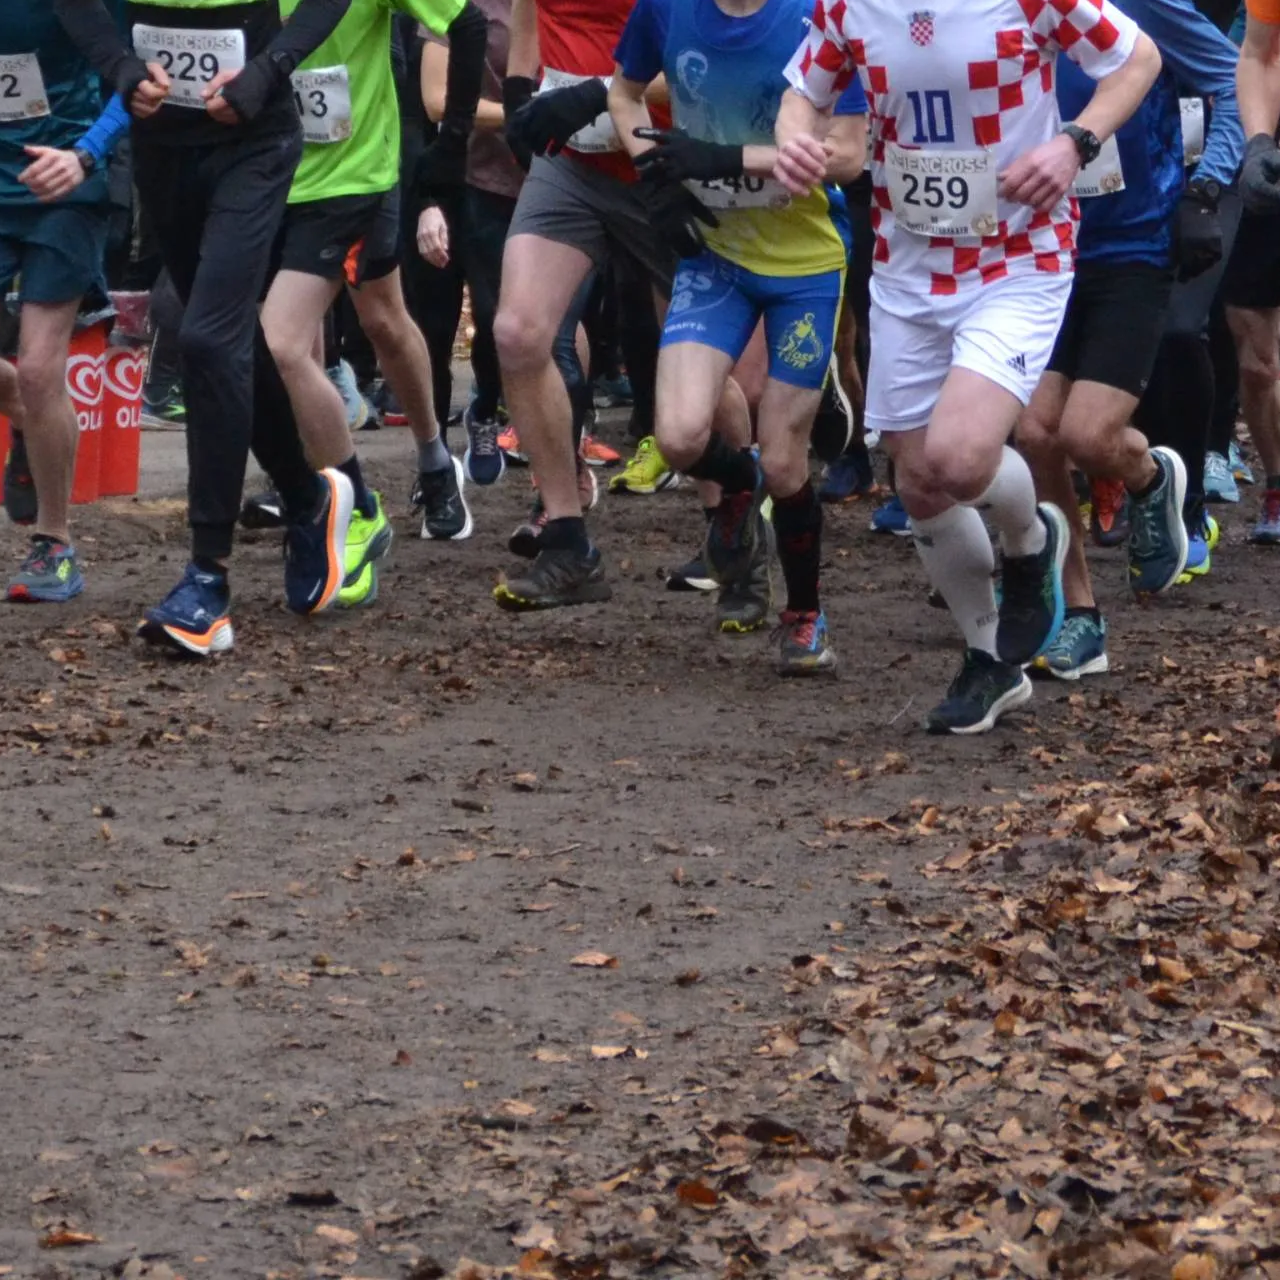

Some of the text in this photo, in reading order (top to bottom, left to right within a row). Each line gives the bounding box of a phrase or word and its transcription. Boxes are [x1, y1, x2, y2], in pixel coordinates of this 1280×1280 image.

[156, 49, 220, 83] 229
[906, 89, 956, 143] 10
[901, 173, 970, 209] 259
